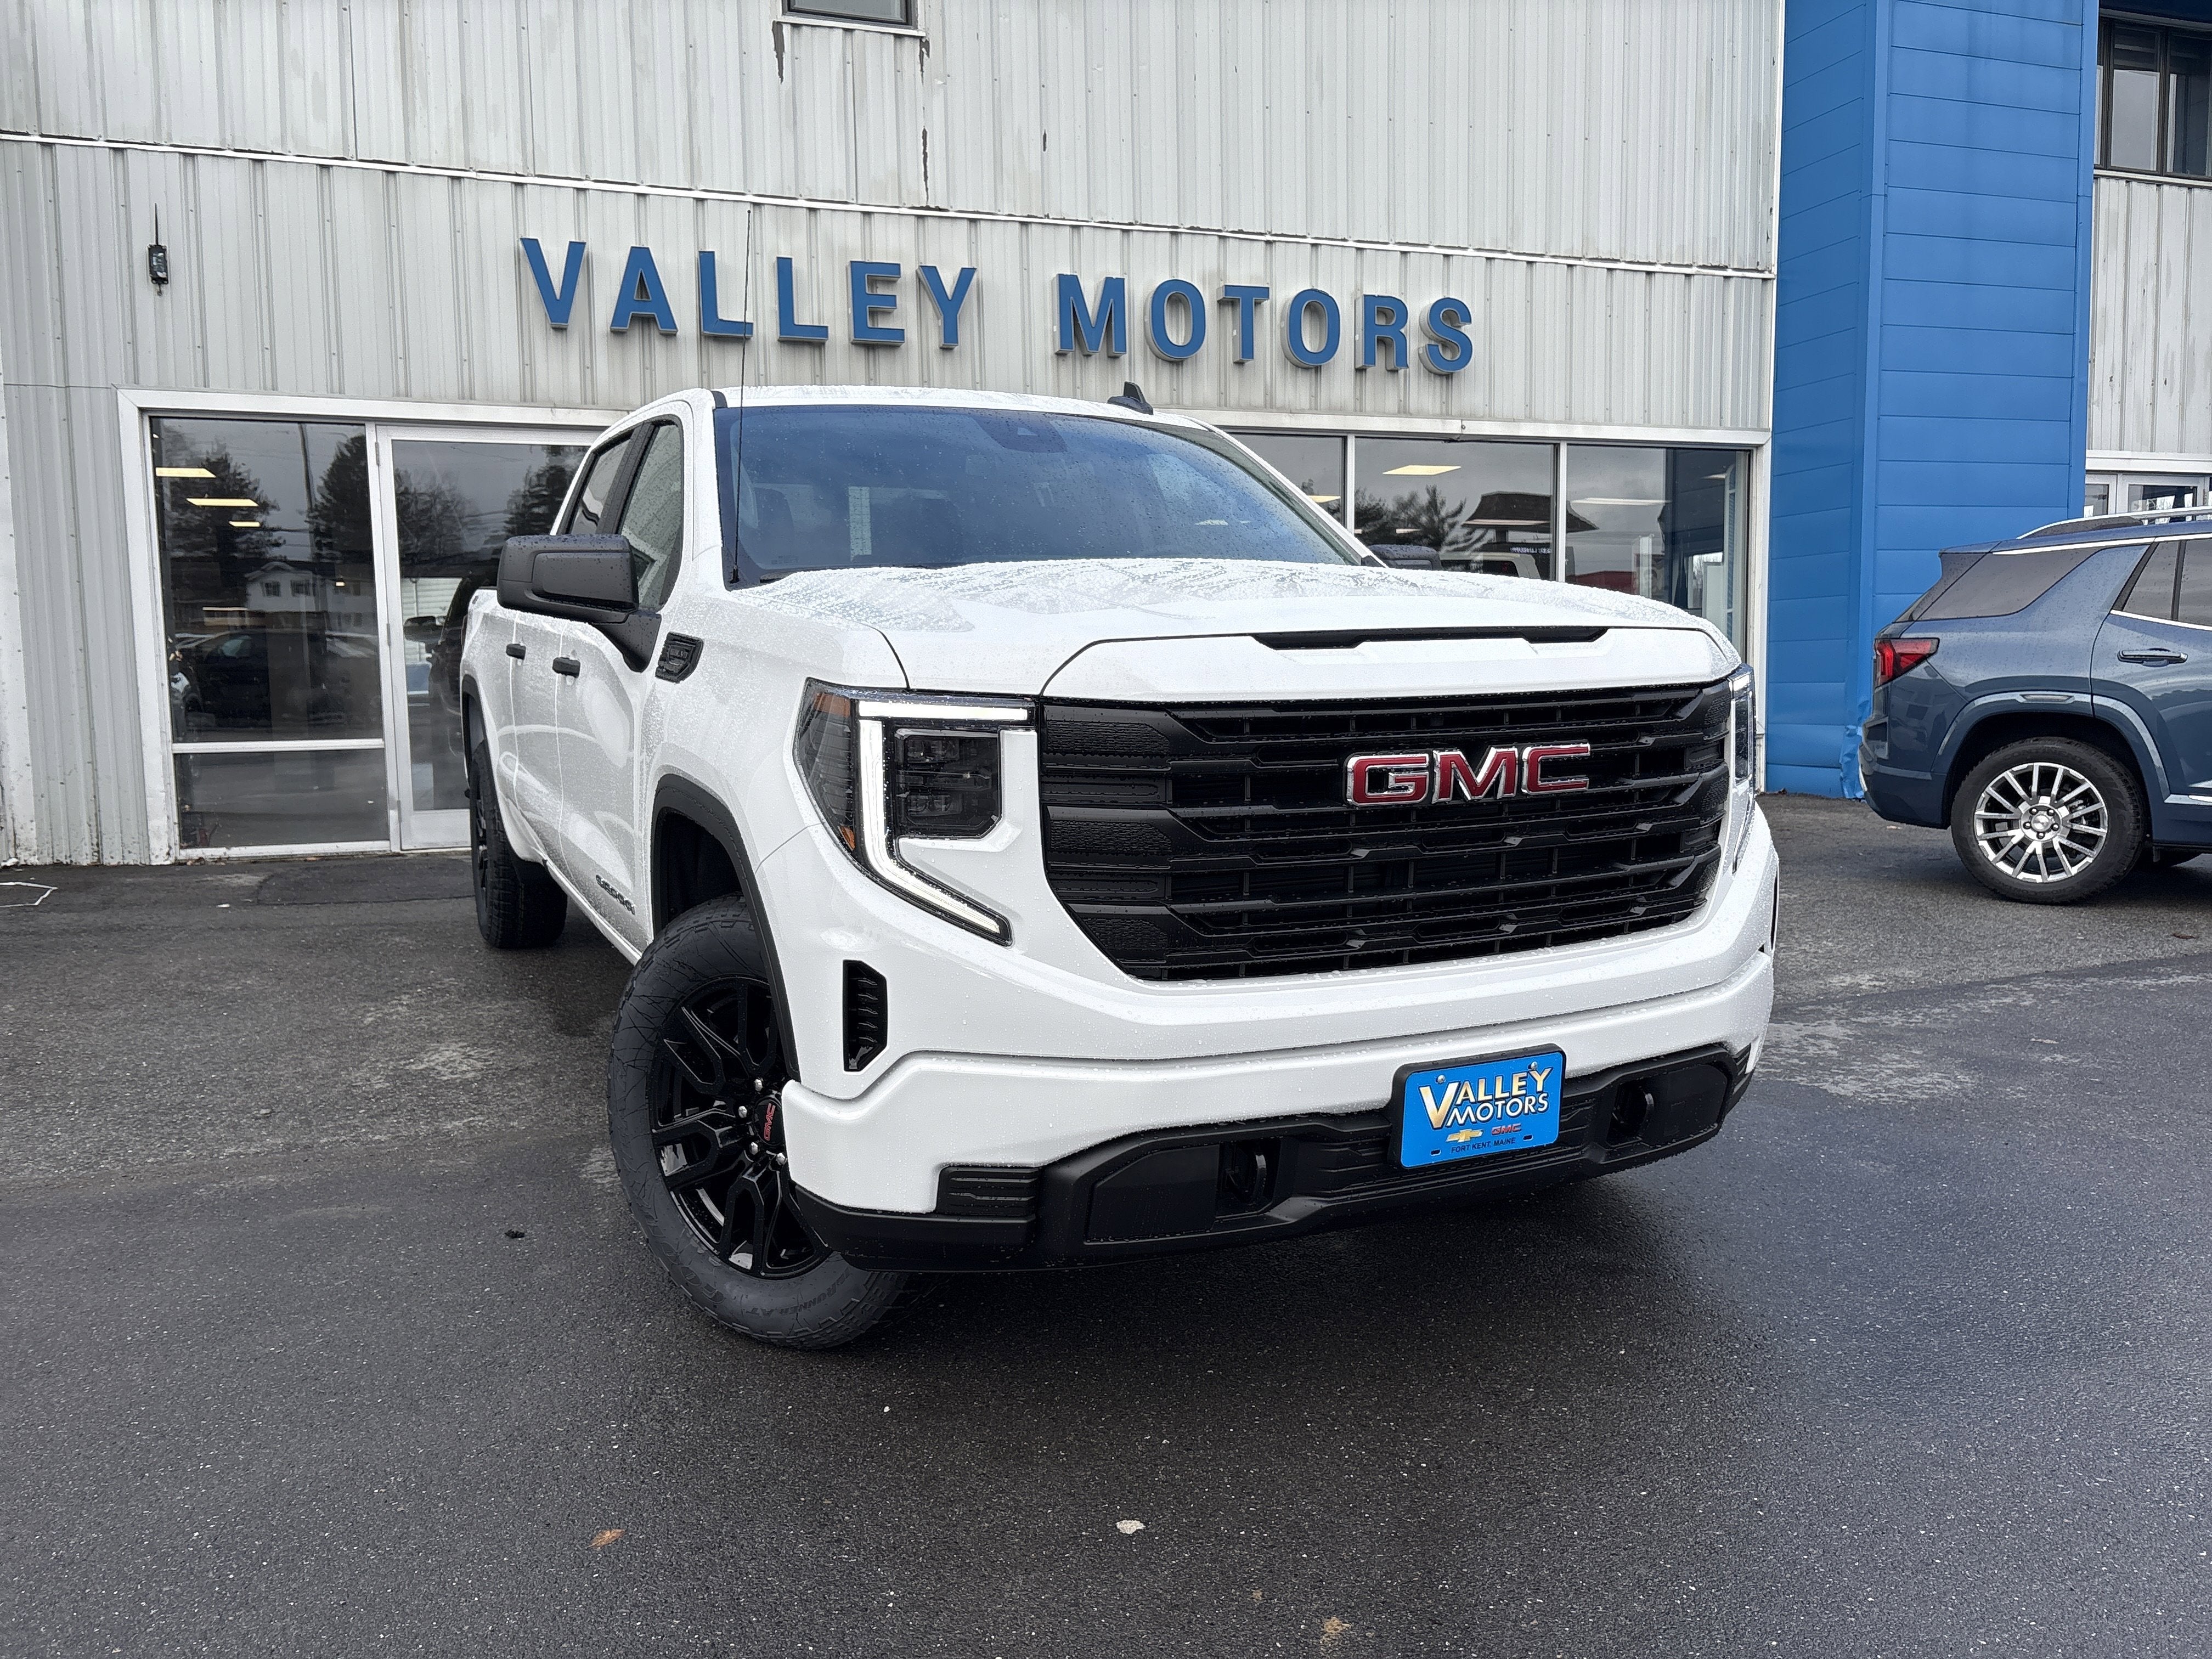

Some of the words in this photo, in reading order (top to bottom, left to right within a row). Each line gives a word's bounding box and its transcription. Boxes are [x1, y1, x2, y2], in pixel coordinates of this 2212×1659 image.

[520, 238, 977, 349] VALLEY
[1054, 273, 1473, 375] MOTORS
[1346, 743, 1590, 806] GMC
[1419, 1066, 1553, 1130] VALLEY
[1446, 1092, 1549, 1127] MOTORS
[764, 1103, 776, 1141] GMC
[1491, 1123, 1522, 1136] GMC
[1451, 1144, 1470, 1153] FORT
[1472, 1141, 1491, 1150] KENT,
[1493, 1137, 1516, 1147] MAINE
